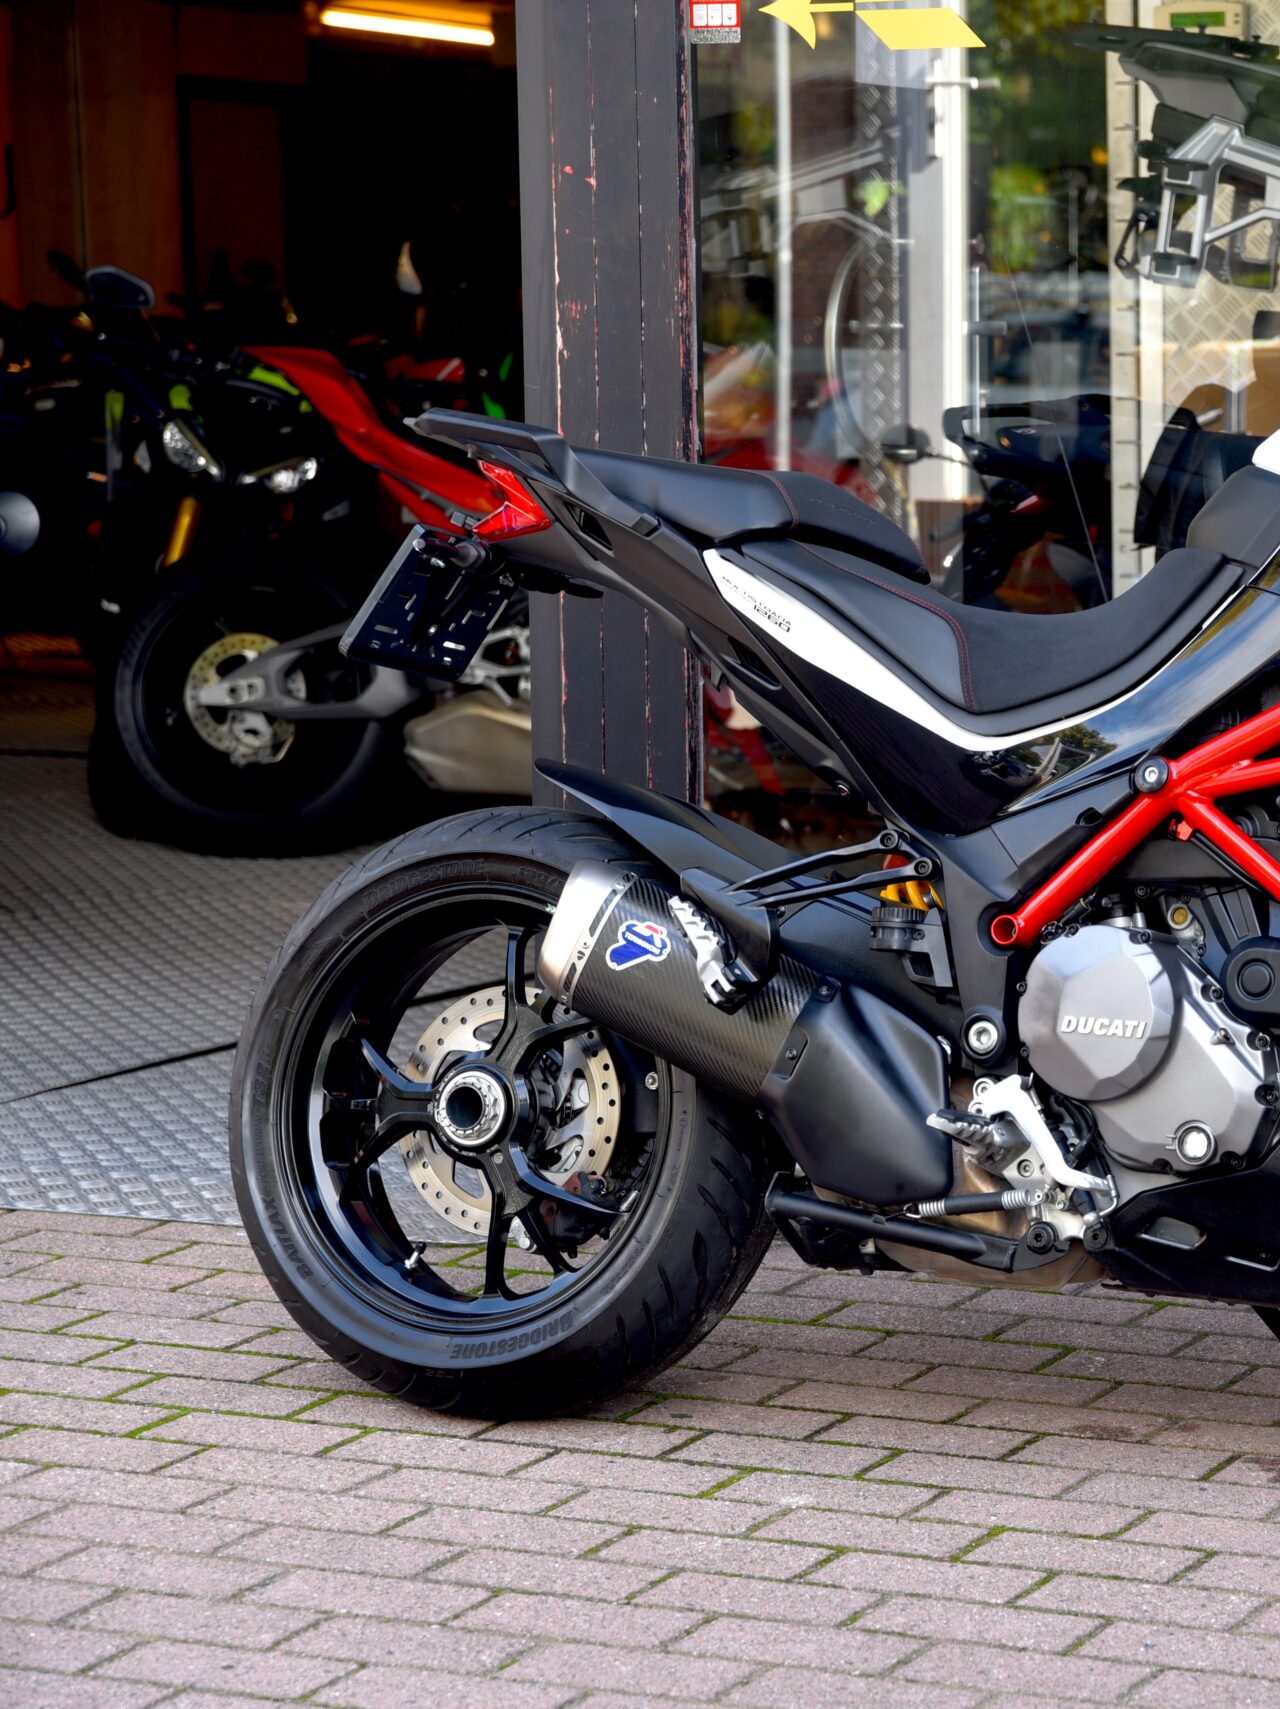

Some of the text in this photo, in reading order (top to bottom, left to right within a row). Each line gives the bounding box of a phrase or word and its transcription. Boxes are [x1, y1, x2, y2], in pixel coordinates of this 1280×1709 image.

[753, 604, 791, 633] 1260
[362, 859, 487, 912] BRIDGESTONE
[1061, 1015, 1147, 1039] DUCATI
[451, 1309, 576, 1361] BRIDGESTONE
